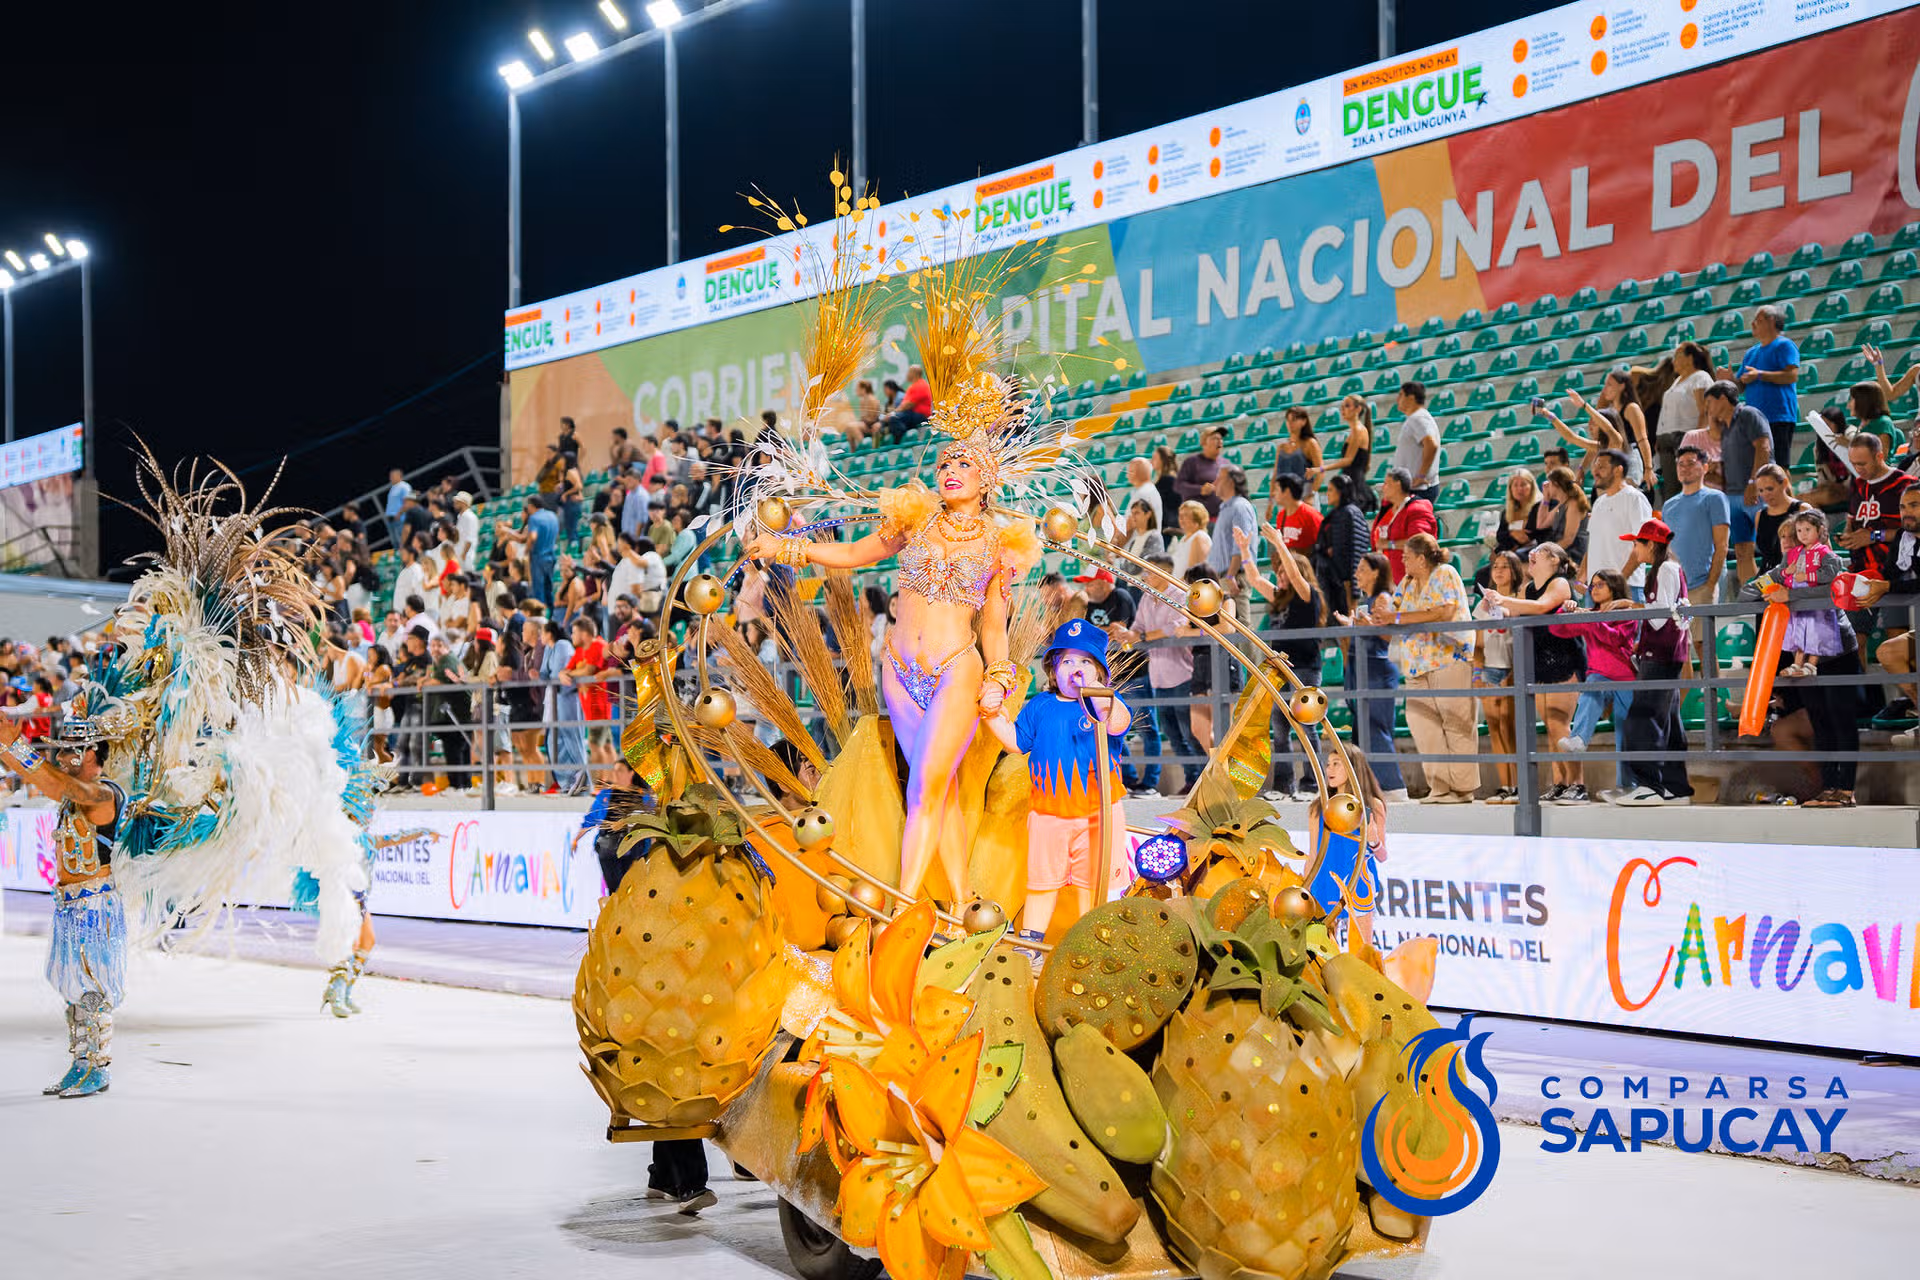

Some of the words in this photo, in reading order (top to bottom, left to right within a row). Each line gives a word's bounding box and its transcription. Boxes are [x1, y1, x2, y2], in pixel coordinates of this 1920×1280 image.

[1361, 63, 1417, 88] MOSQUITOS
[1343, 64, 1483, 137] DENGUE
[1352, 133, 1376, 148] ZIKA
[1377, 131, 1385, 142] Y
[1387, 109, 1468, 139] CHIKUNGUNYA
[974, 179, 1072, 234] DENGUE
[1196, 166, 1615, 327] NACIONAL
[1651, 108, 1853, 233] DEL
[705, 260, 779, 304] DENGUE
[1510, 938, 1551, 963] DEL
